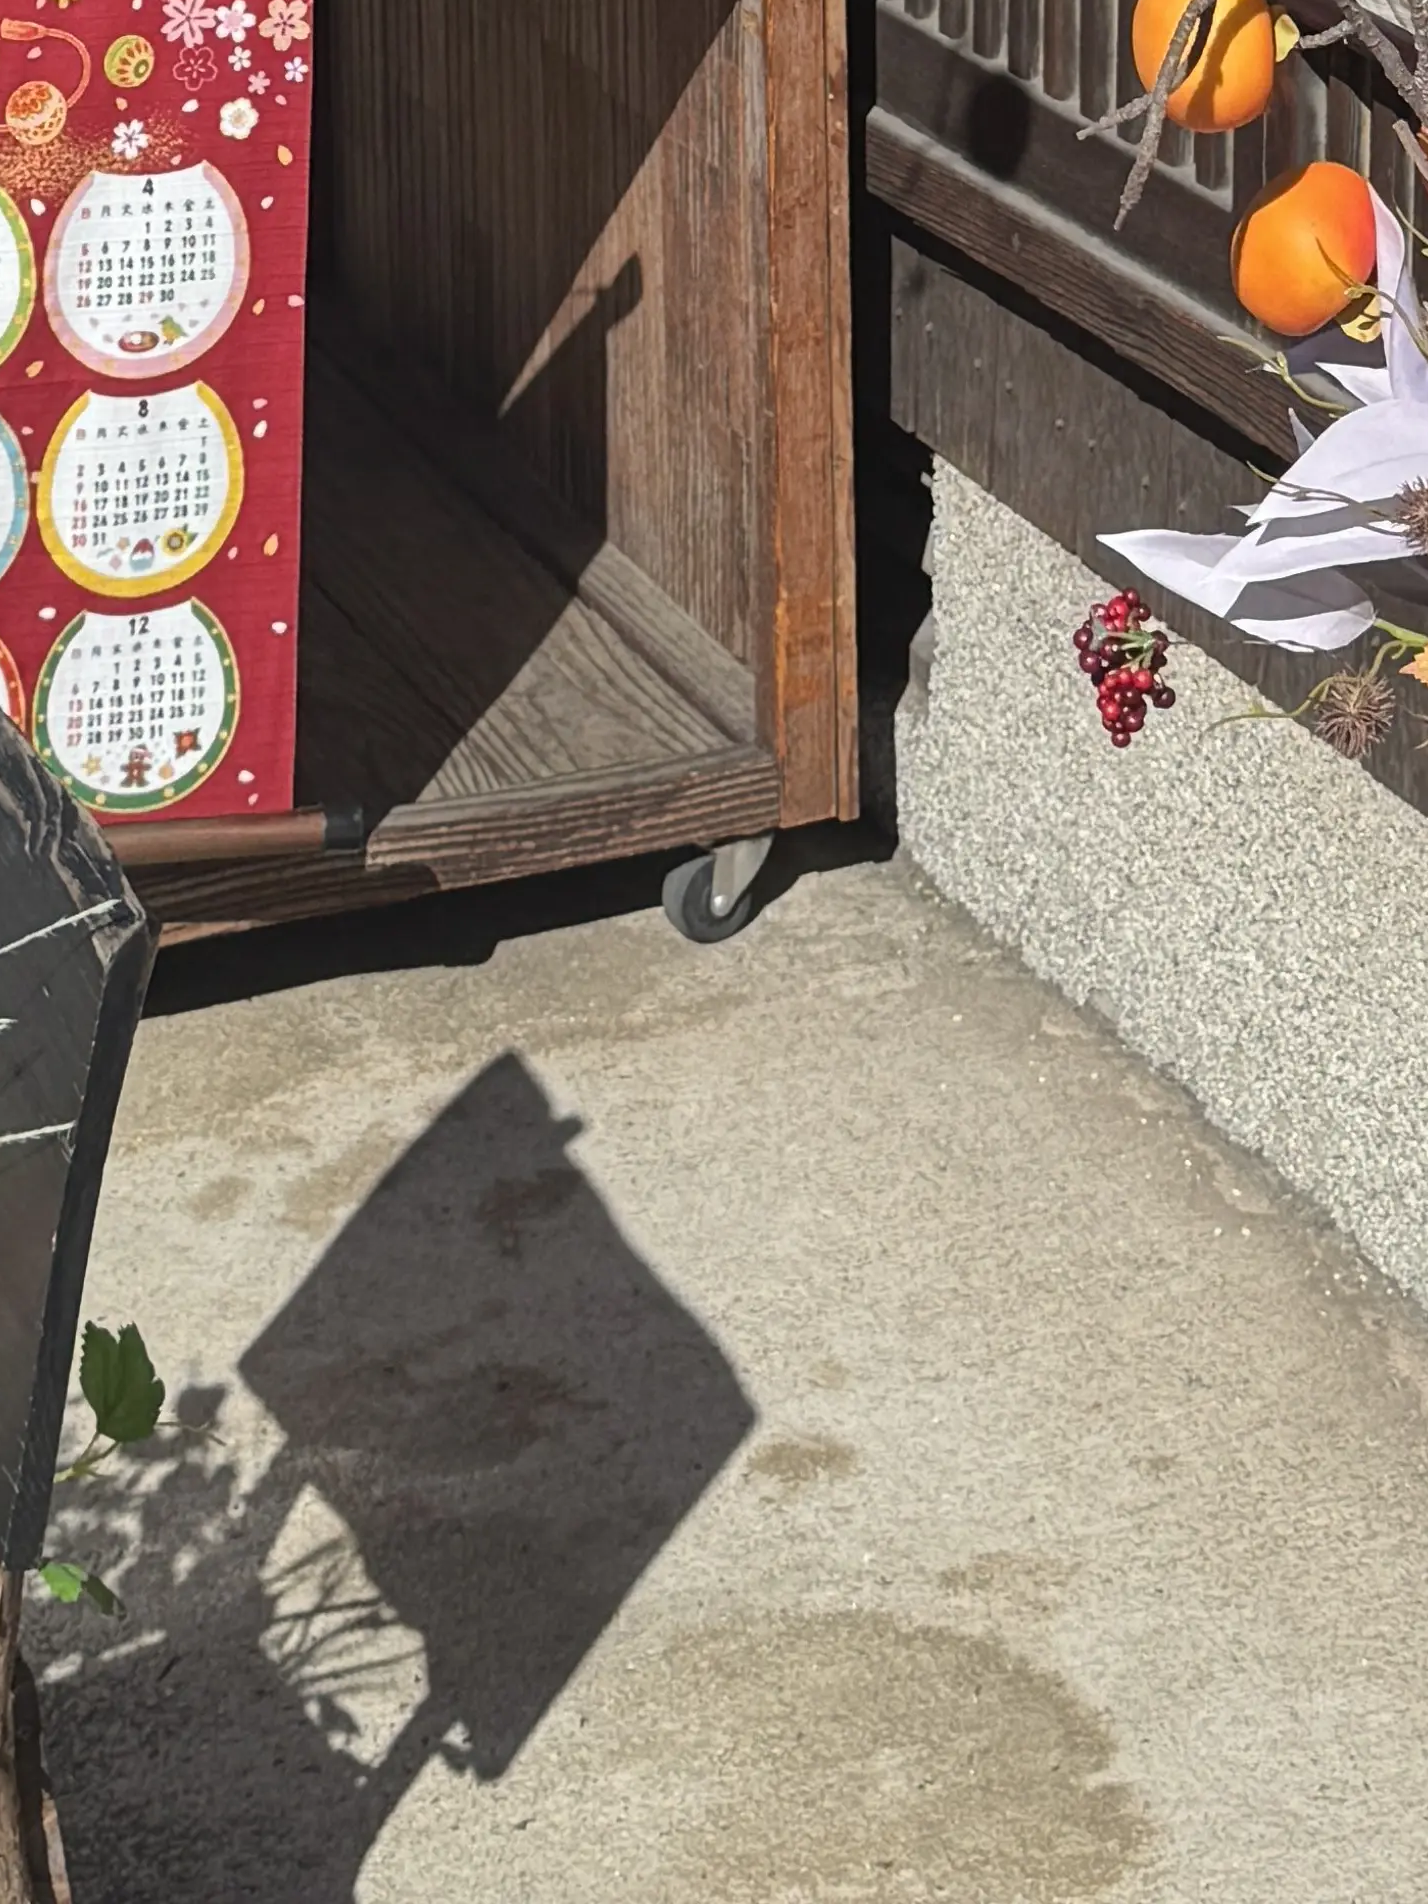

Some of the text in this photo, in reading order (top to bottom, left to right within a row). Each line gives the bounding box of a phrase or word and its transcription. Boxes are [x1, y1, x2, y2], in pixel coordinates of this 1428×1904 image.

[142, 177, 154, 195] 4
[145, 216, 213, 234] 1 2 3 4
[82, 234, 216, 256] 5 6 7 8 9 10 11
[78, 250, 215, 274] 12 13 14 15 16 17 18
[78, 267, 215, 290] 19 20 21 22 23 24 25
[76, 289, 174, 308] 26 27 28 29 30
[138, 399, 149, 418] 8
[128, 615, 150, 637] 12
